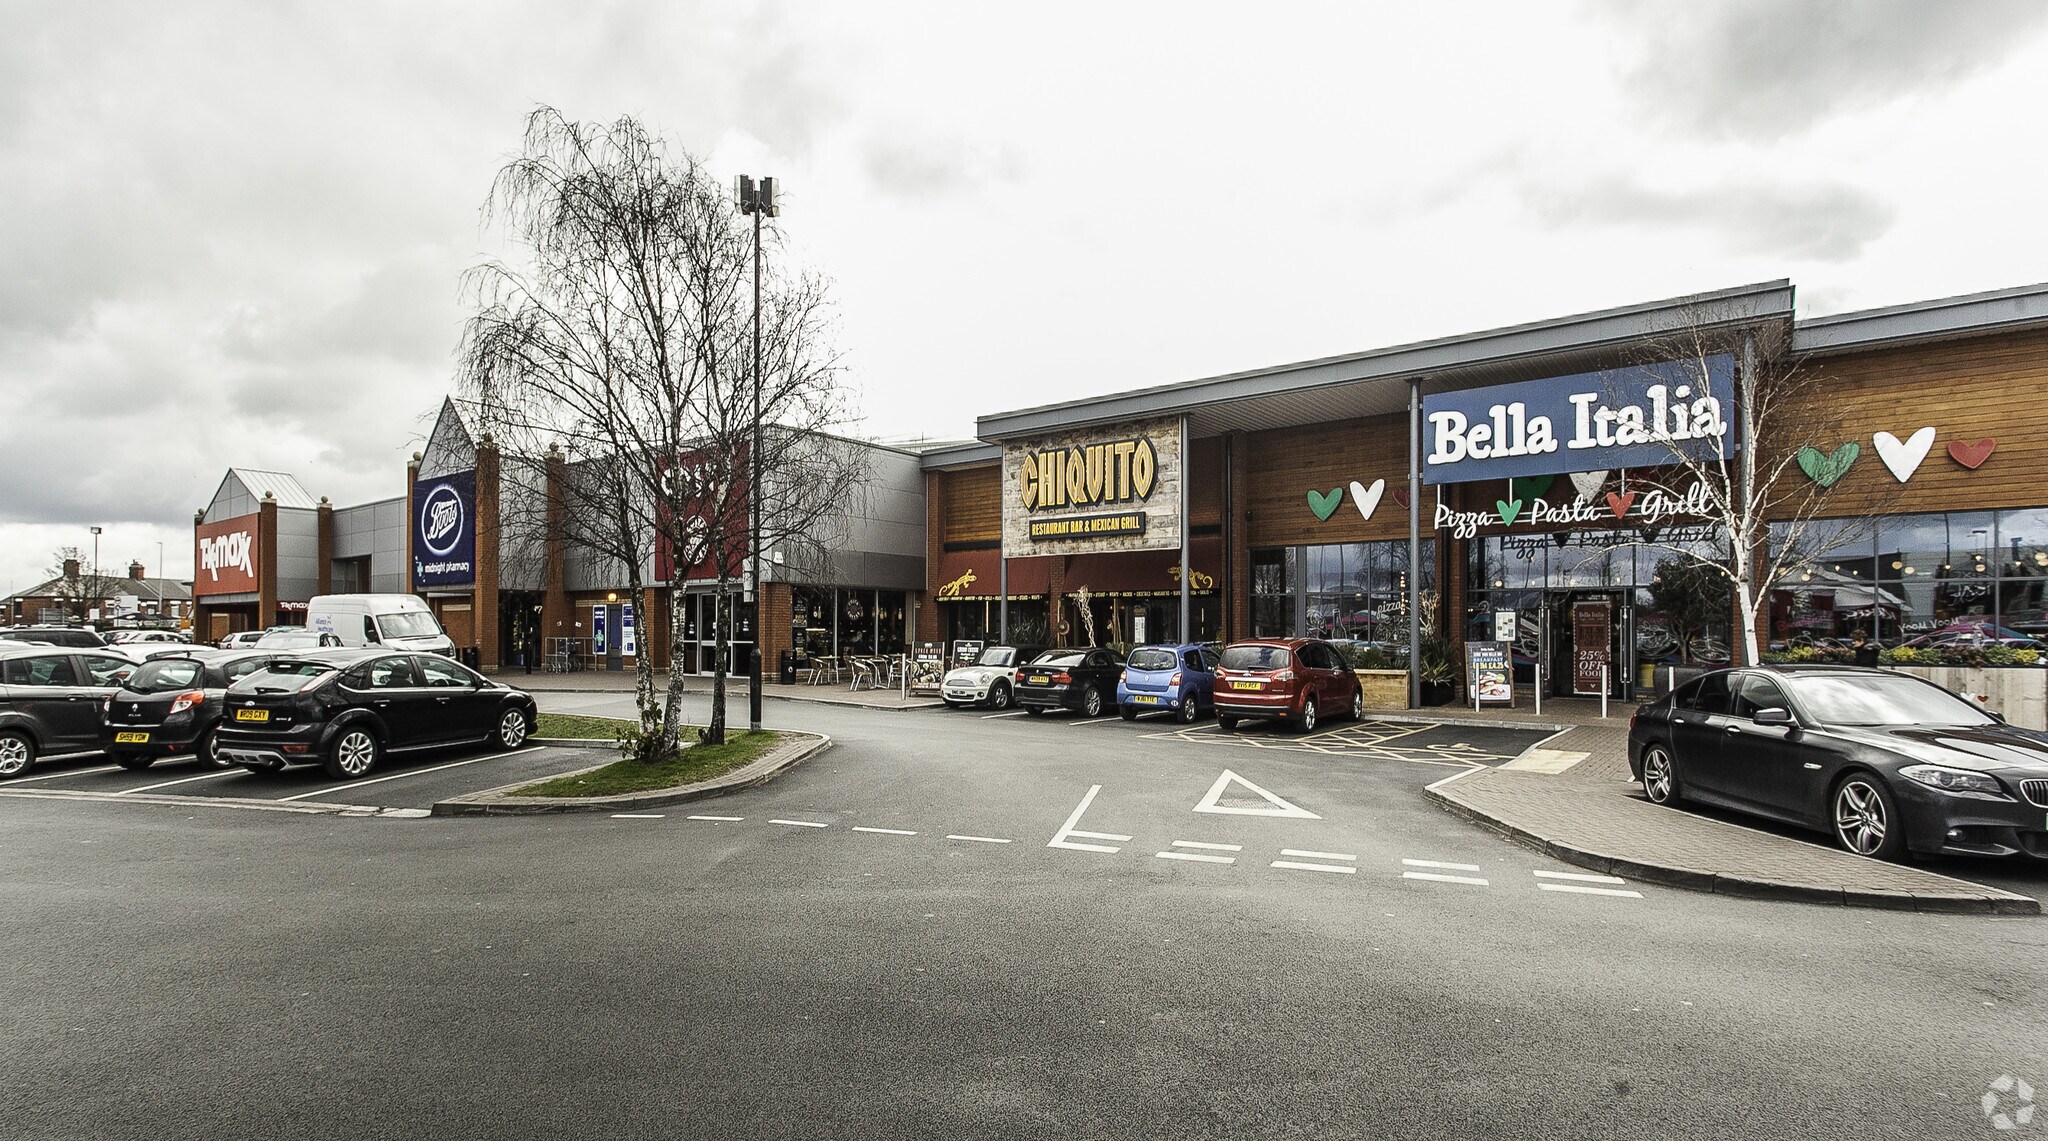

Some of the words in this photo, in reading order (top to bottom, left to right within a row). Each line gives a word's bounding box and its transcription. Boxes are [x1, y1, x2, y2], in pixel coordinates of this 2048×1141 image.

[1428, 402, 1558, 465] Bella
[1567, 384, 1728, 450] Italia
[1020, 437, 1156, 511] CHIQUITO
[427, 499, 458, 540] Boots
[1434, 503, 1493, 539] Pizza
[1531, 494, 1601, 525] Pasta
[1640, 482, 1715, 524] Grill
[1031, 521, 1069, 537] RESTAURANT
[1070, 519, 1083, 533] BAR
[1084, 519, 1090, 532] &
[1091, 517, 1119, 532] MEXICAN
[1120, 516, 1140, 530] GRILL
[425, 563, 446, 574] midnight
[446, 561, 470, 573] pharmacy
[1376, 601, 1401, 620] pizza
[1579, 650, 1605, 660] 25%
[1579, 661, 1605, 670] OFF
